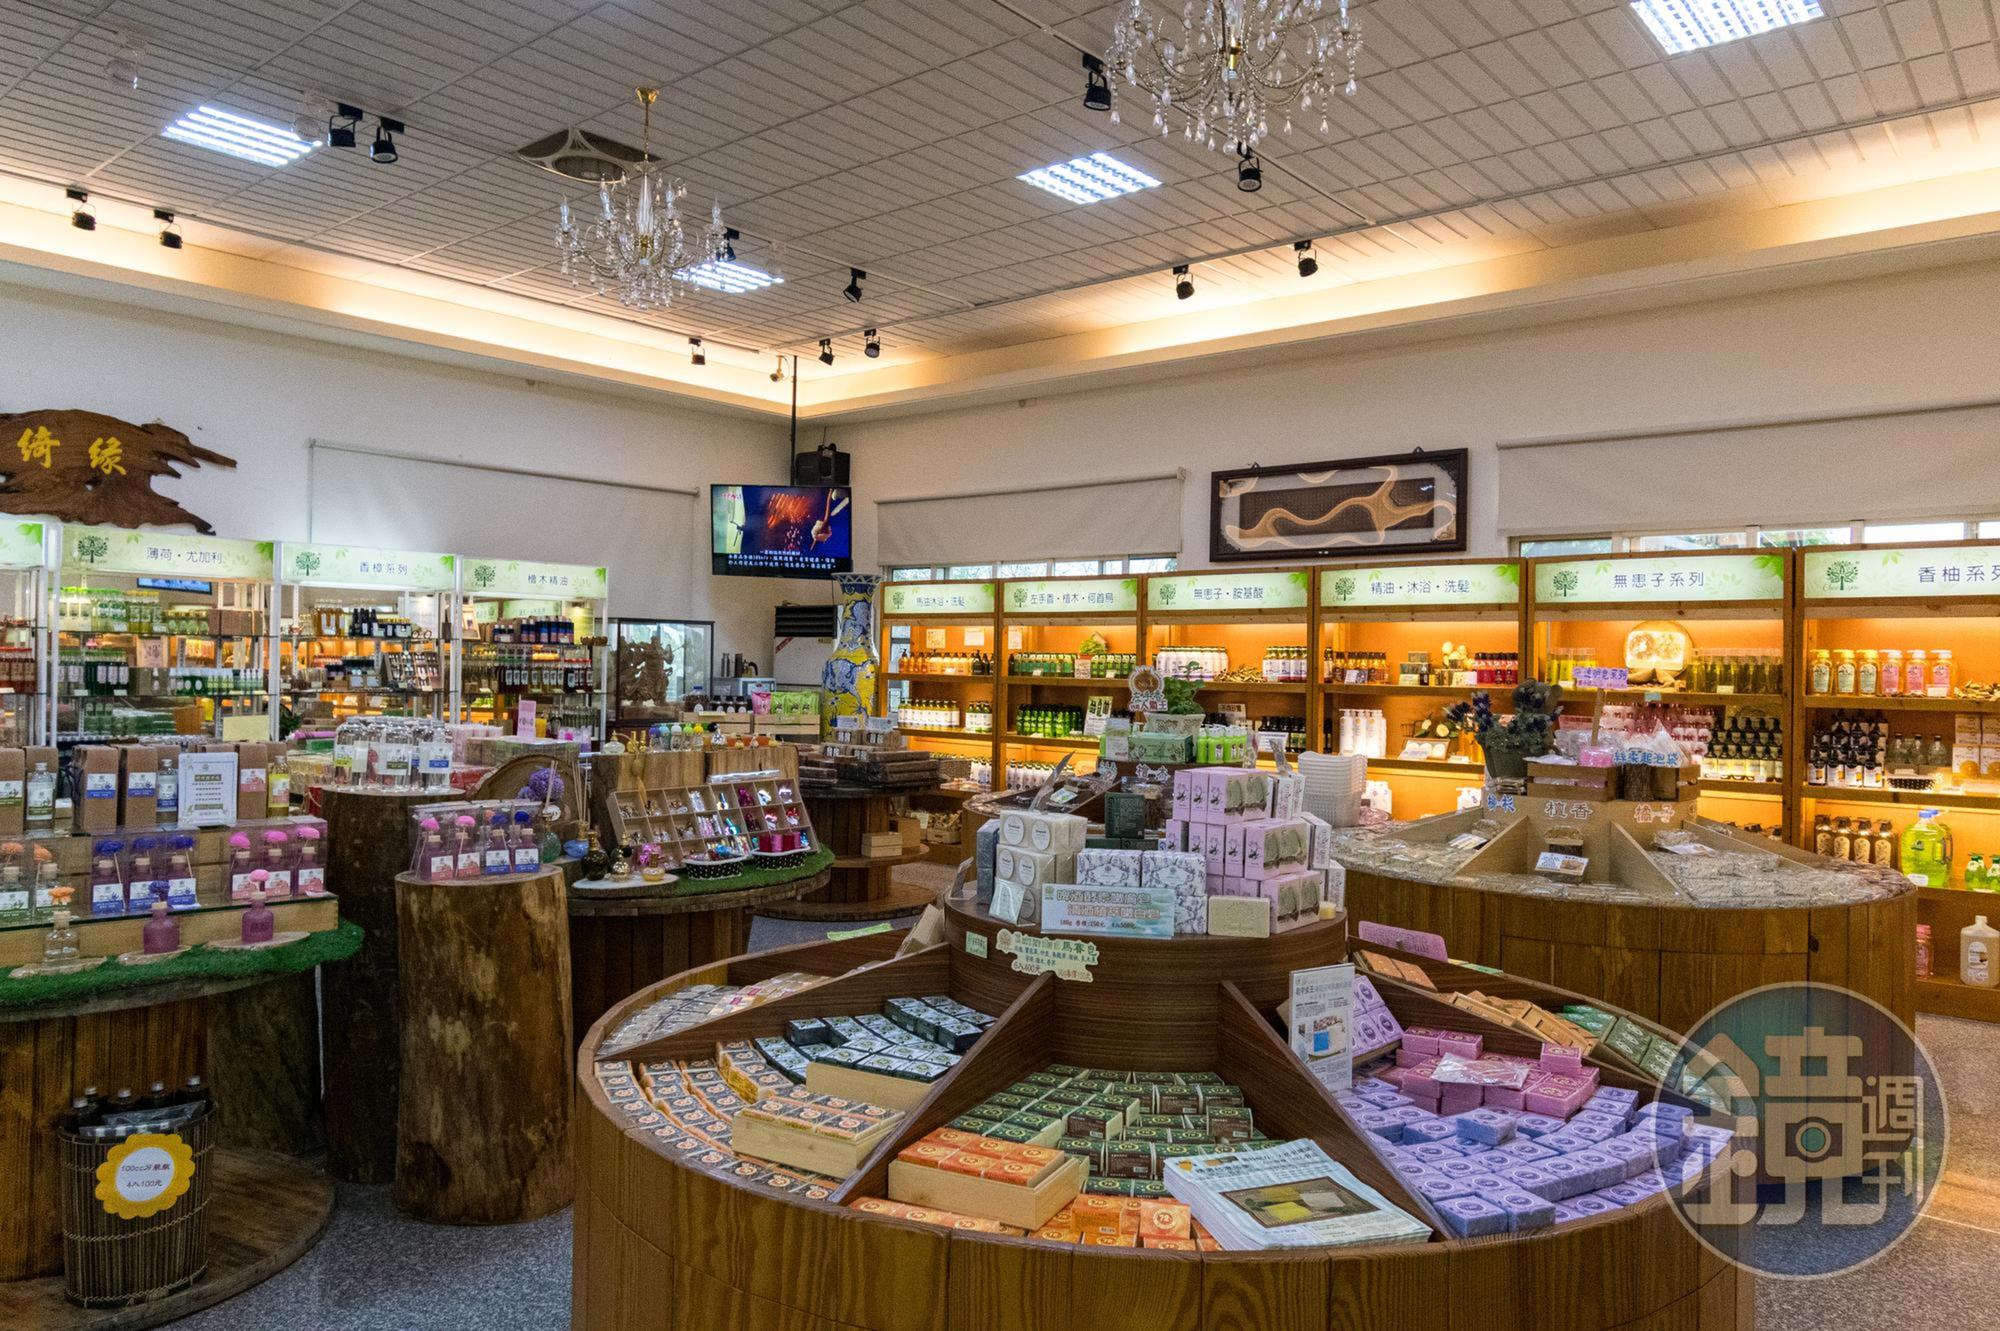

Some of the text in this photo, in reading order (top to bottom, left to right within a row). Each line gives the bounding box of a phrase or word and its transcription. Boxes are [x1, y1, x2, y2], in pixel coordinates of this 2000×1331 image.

[1613, 571, 1705, 589] 無患子系列
[1546, 801, 1592, 818] 檀香
[1635, 804, 1675, 823] 橘子
